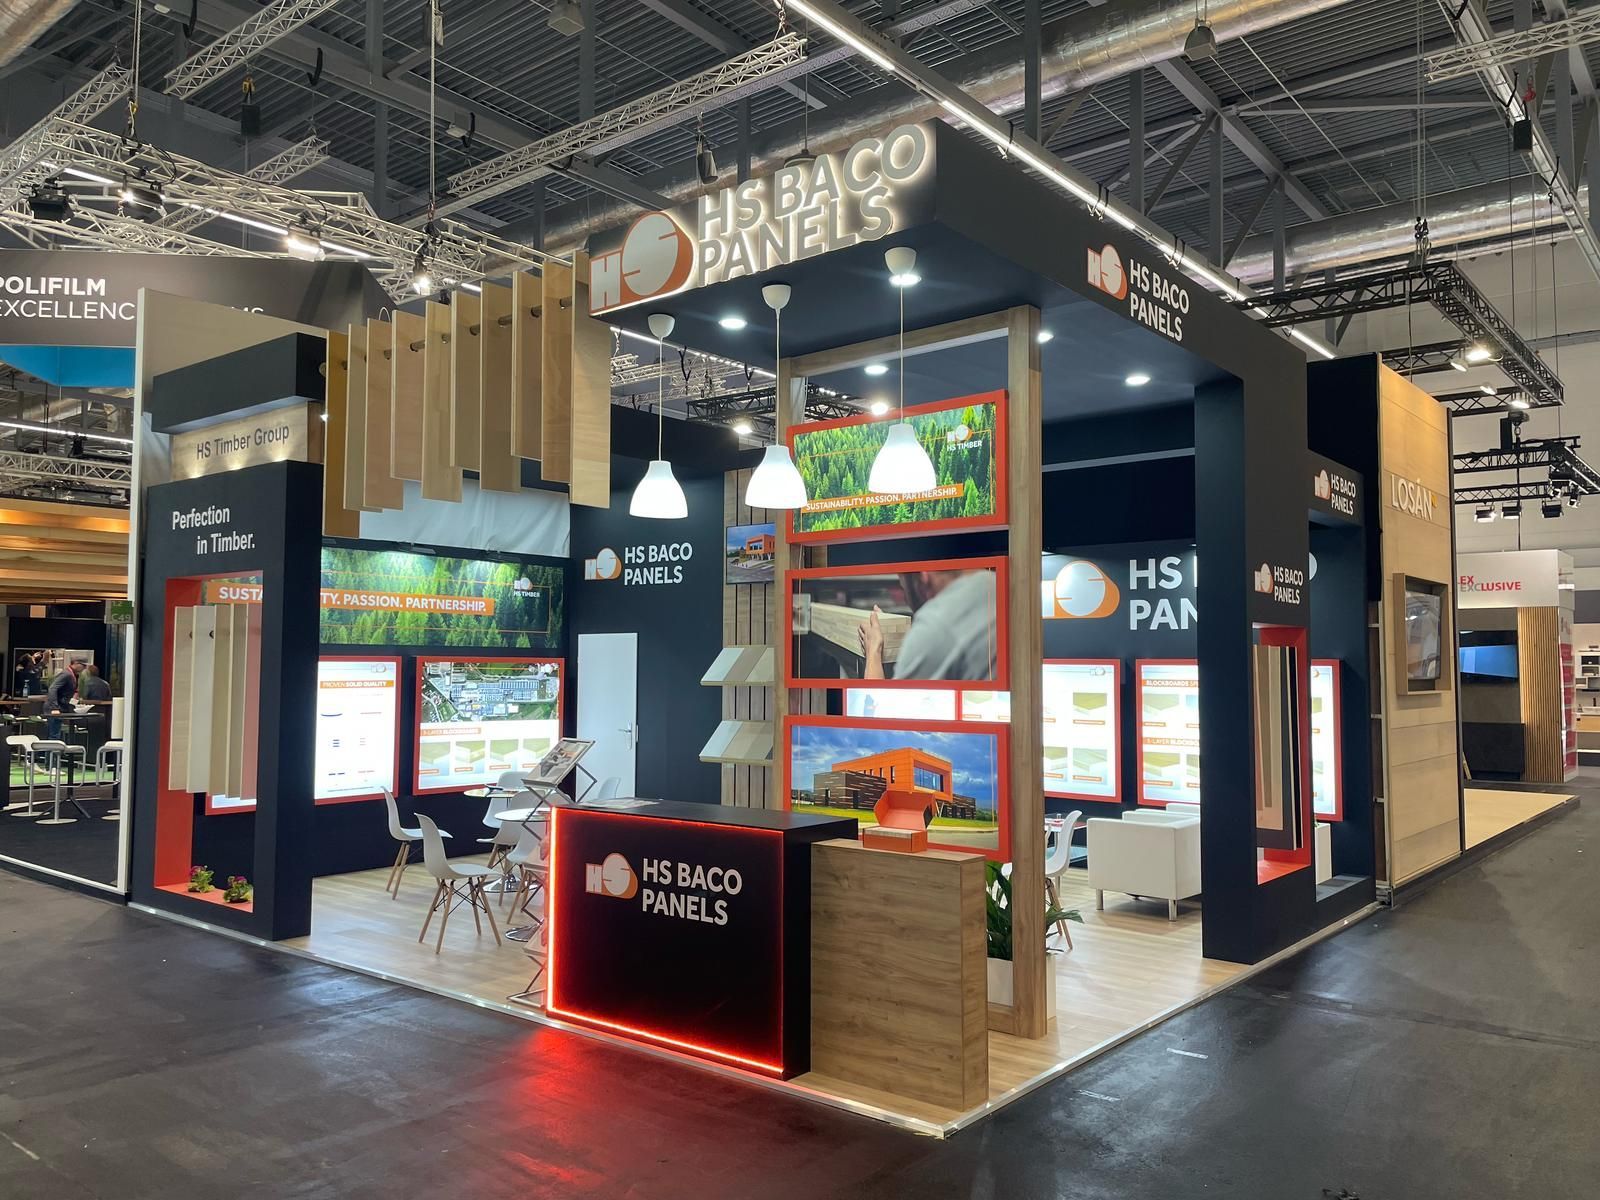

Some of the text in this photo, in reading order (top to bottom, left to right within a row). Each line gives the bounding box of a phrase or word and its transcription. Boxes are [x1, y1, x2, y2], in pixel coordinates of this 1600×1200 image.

[699, 123, 927, 240] HS BACO
[698, 186, 895, 286] PANELS
[0, 275, 106, 296] OLIFILM
[1130, 258, 1190, 314] HS BACO
[1130, 292, 1183, 342] PANELS
[197, 425, 290, 460] HS Timber Group
[957, 440, 982, 450] TIMBER
[1331, 473, 1356, 499] HS BACO
[1391, 474, 1432, 520] LOSÁN
[806, 487, 958, 511] SUSTAINABILITY. PASSION. PARTNERSHIP.
[1331, 493, 1354, 516] PANELS
[172, 505, 230, 530] Perfection
[197, 531, 255, 555] in Timber.
[625, 542, 693, 564] HS BACO
[624, 565, 683, 586] PANELS
[1129, 556, 1183, 590] HS
[1274, 566, 1304, 586] HS BACO
[343, 593, 403, 608] PASSION.
[405, 597, 487, 612] PARTNERSHIP.
[1274, 585, 1301, 605] PANELS
[642, 858, 743, 895] HS BACO
[642, 888, 729, 926] PANELS
